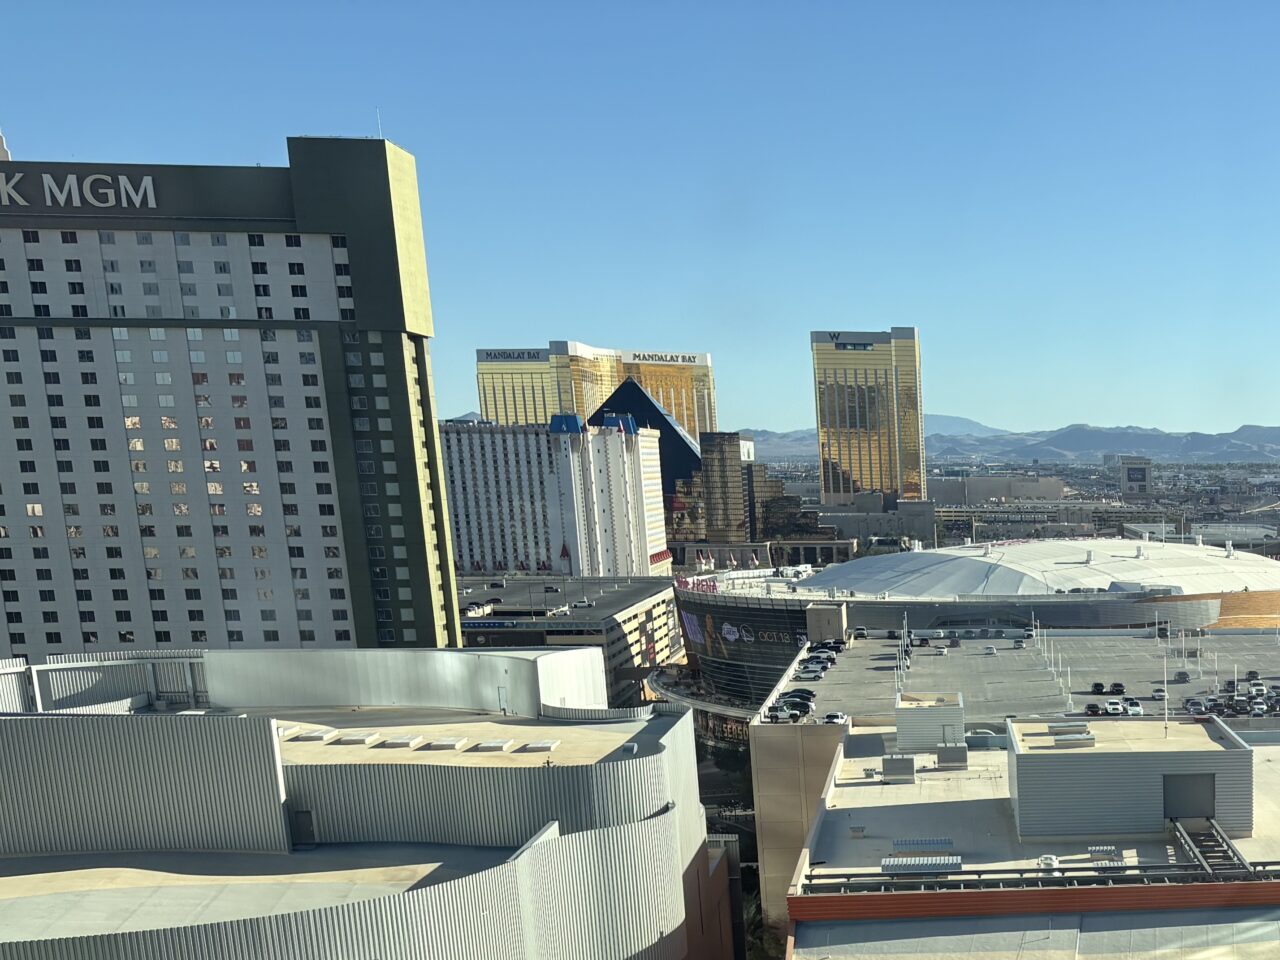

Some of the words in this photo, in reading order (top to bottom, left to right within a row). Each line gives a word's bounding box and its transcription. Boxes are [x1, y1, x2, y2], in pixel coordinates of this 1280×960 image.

[41, 173, 157, 208] MGM
[828, 332, 840, 341] W
[485, 351, 525, 360] MANDALAY
[527, 351, 541, 360] BAY
[632, 353, 679, 363] MANDALAY
[681, 355, 697, 363] BAY
[758, 631, 777, 642] OCT
